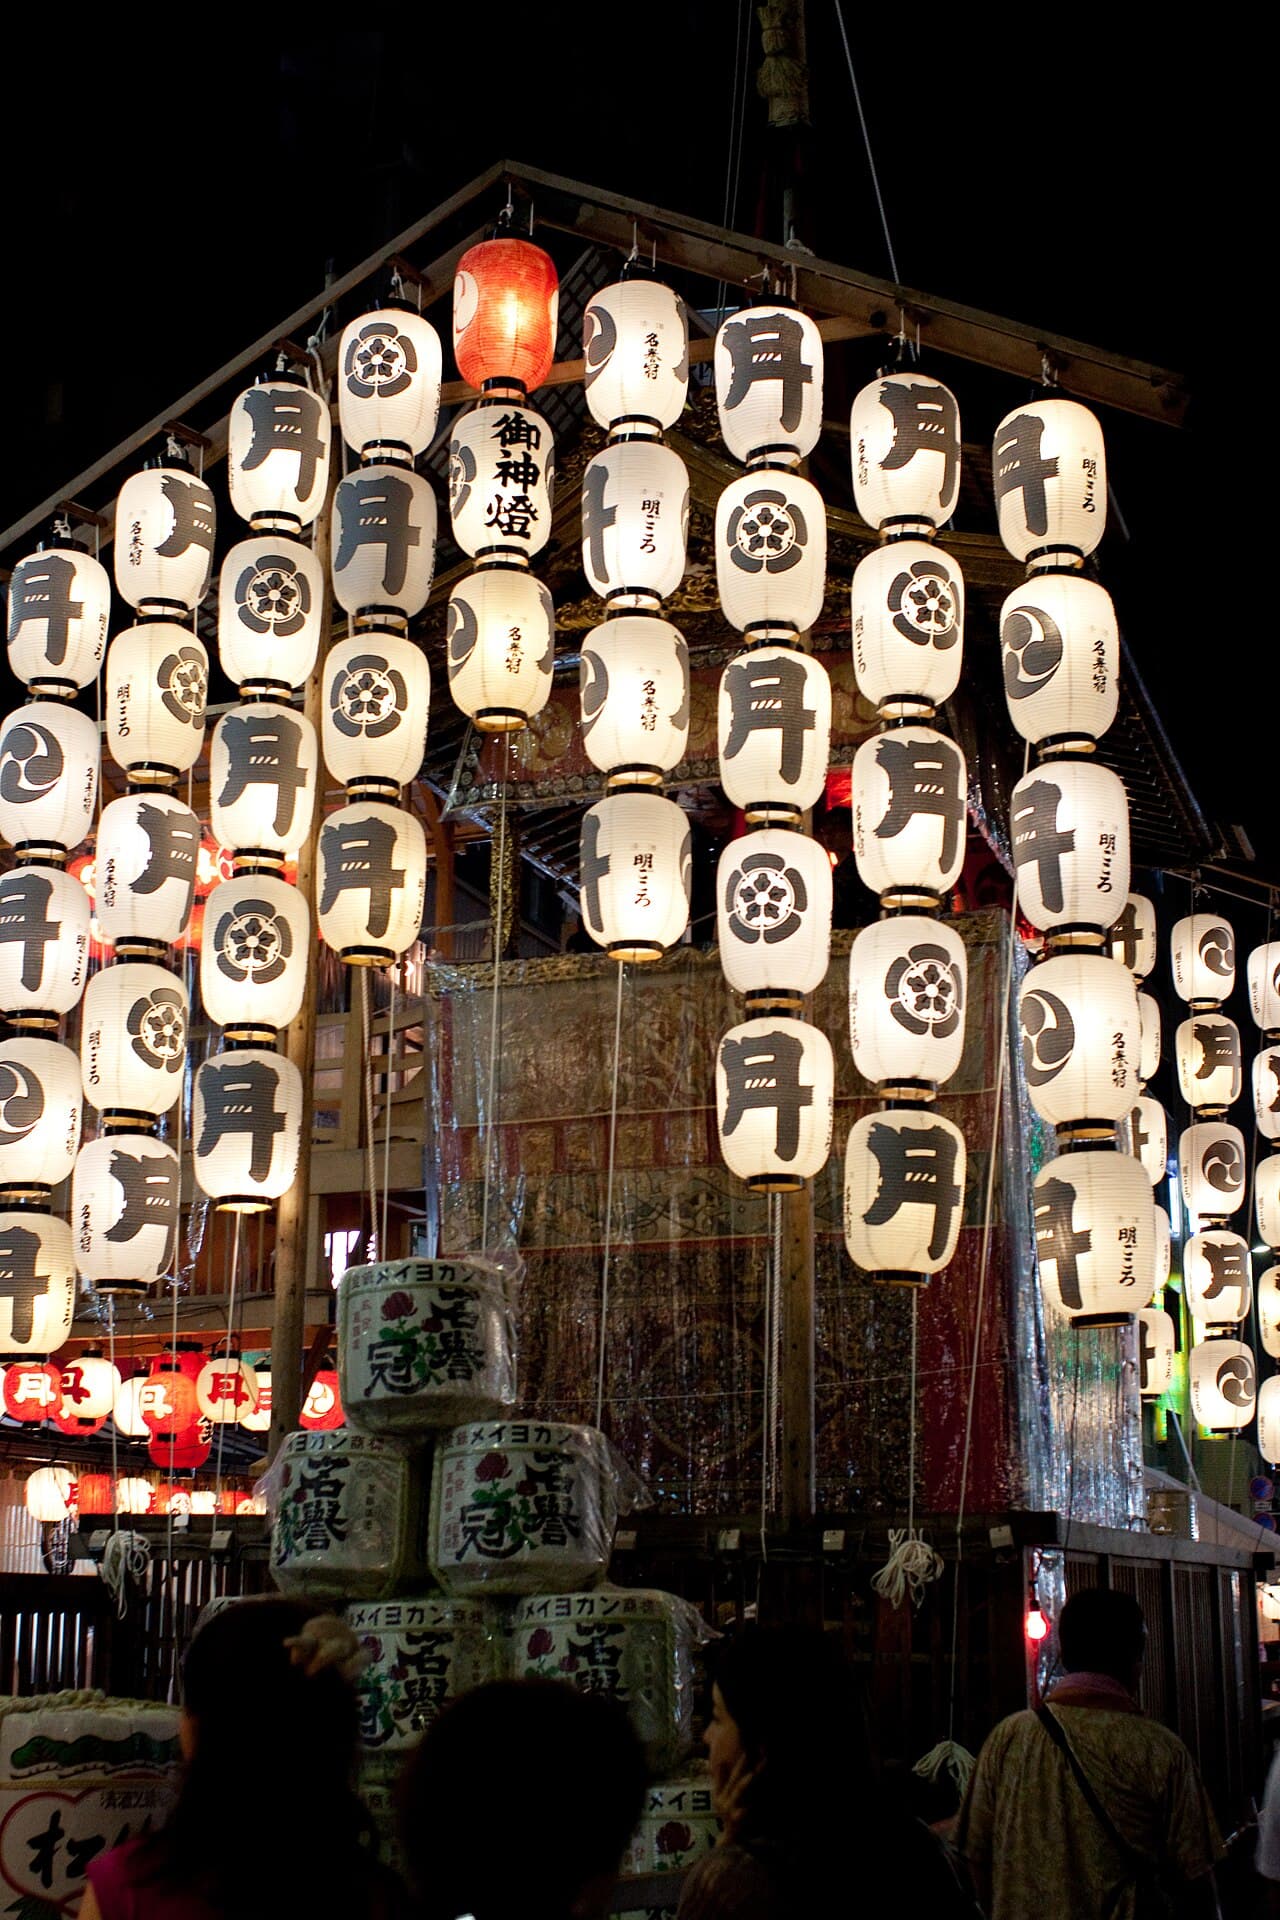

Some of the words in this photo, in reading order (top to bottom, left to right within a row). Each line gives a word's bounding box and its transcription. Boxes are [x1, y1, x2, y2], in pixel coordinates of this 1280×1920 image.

[484, 411, 541, 540] 御神燈
[1119, 1227, 1137, 1288] 明ごころ
[377, 1264, 475, 1285] メイヨカン
[356, 1606, 444, 1627] メイヨカン
[526, 1597, 619, 1620] メイヨカン
